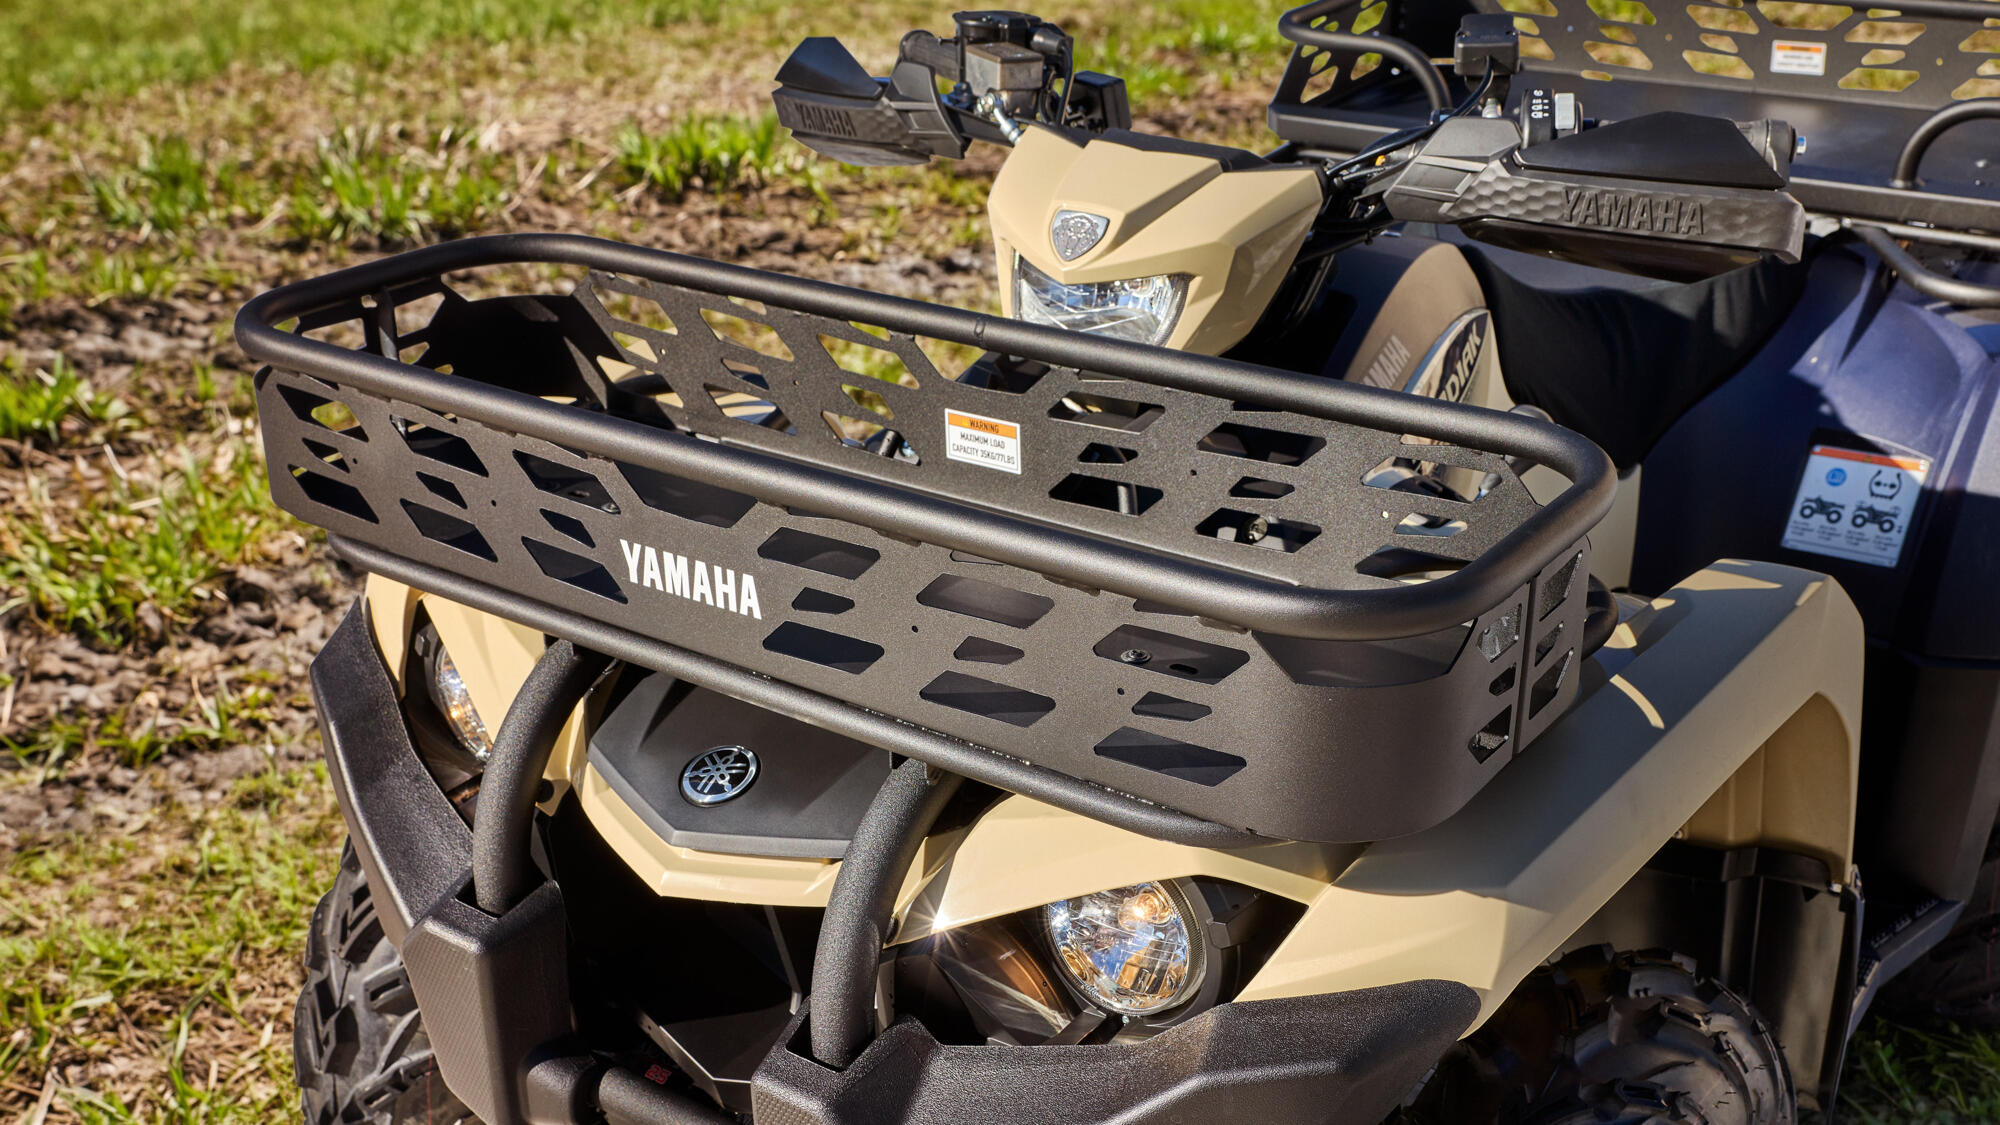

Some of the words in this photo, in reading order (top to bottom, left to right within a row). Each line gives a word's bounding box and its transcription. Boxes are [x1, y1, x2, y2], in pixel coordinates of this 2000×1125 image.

[795, 103, 857, 137] YAMAHA
[1561, 186, 1704, 235] YAMAHA
[969, 419, 999, 433] WARNING
[952, 443, 979, 457] CAPACITY
[960, 431, 989, 446] MAXIMUM
[990, 438, 1006, 449] LOAD
[619, 538, 762, 620] YAMAHA
